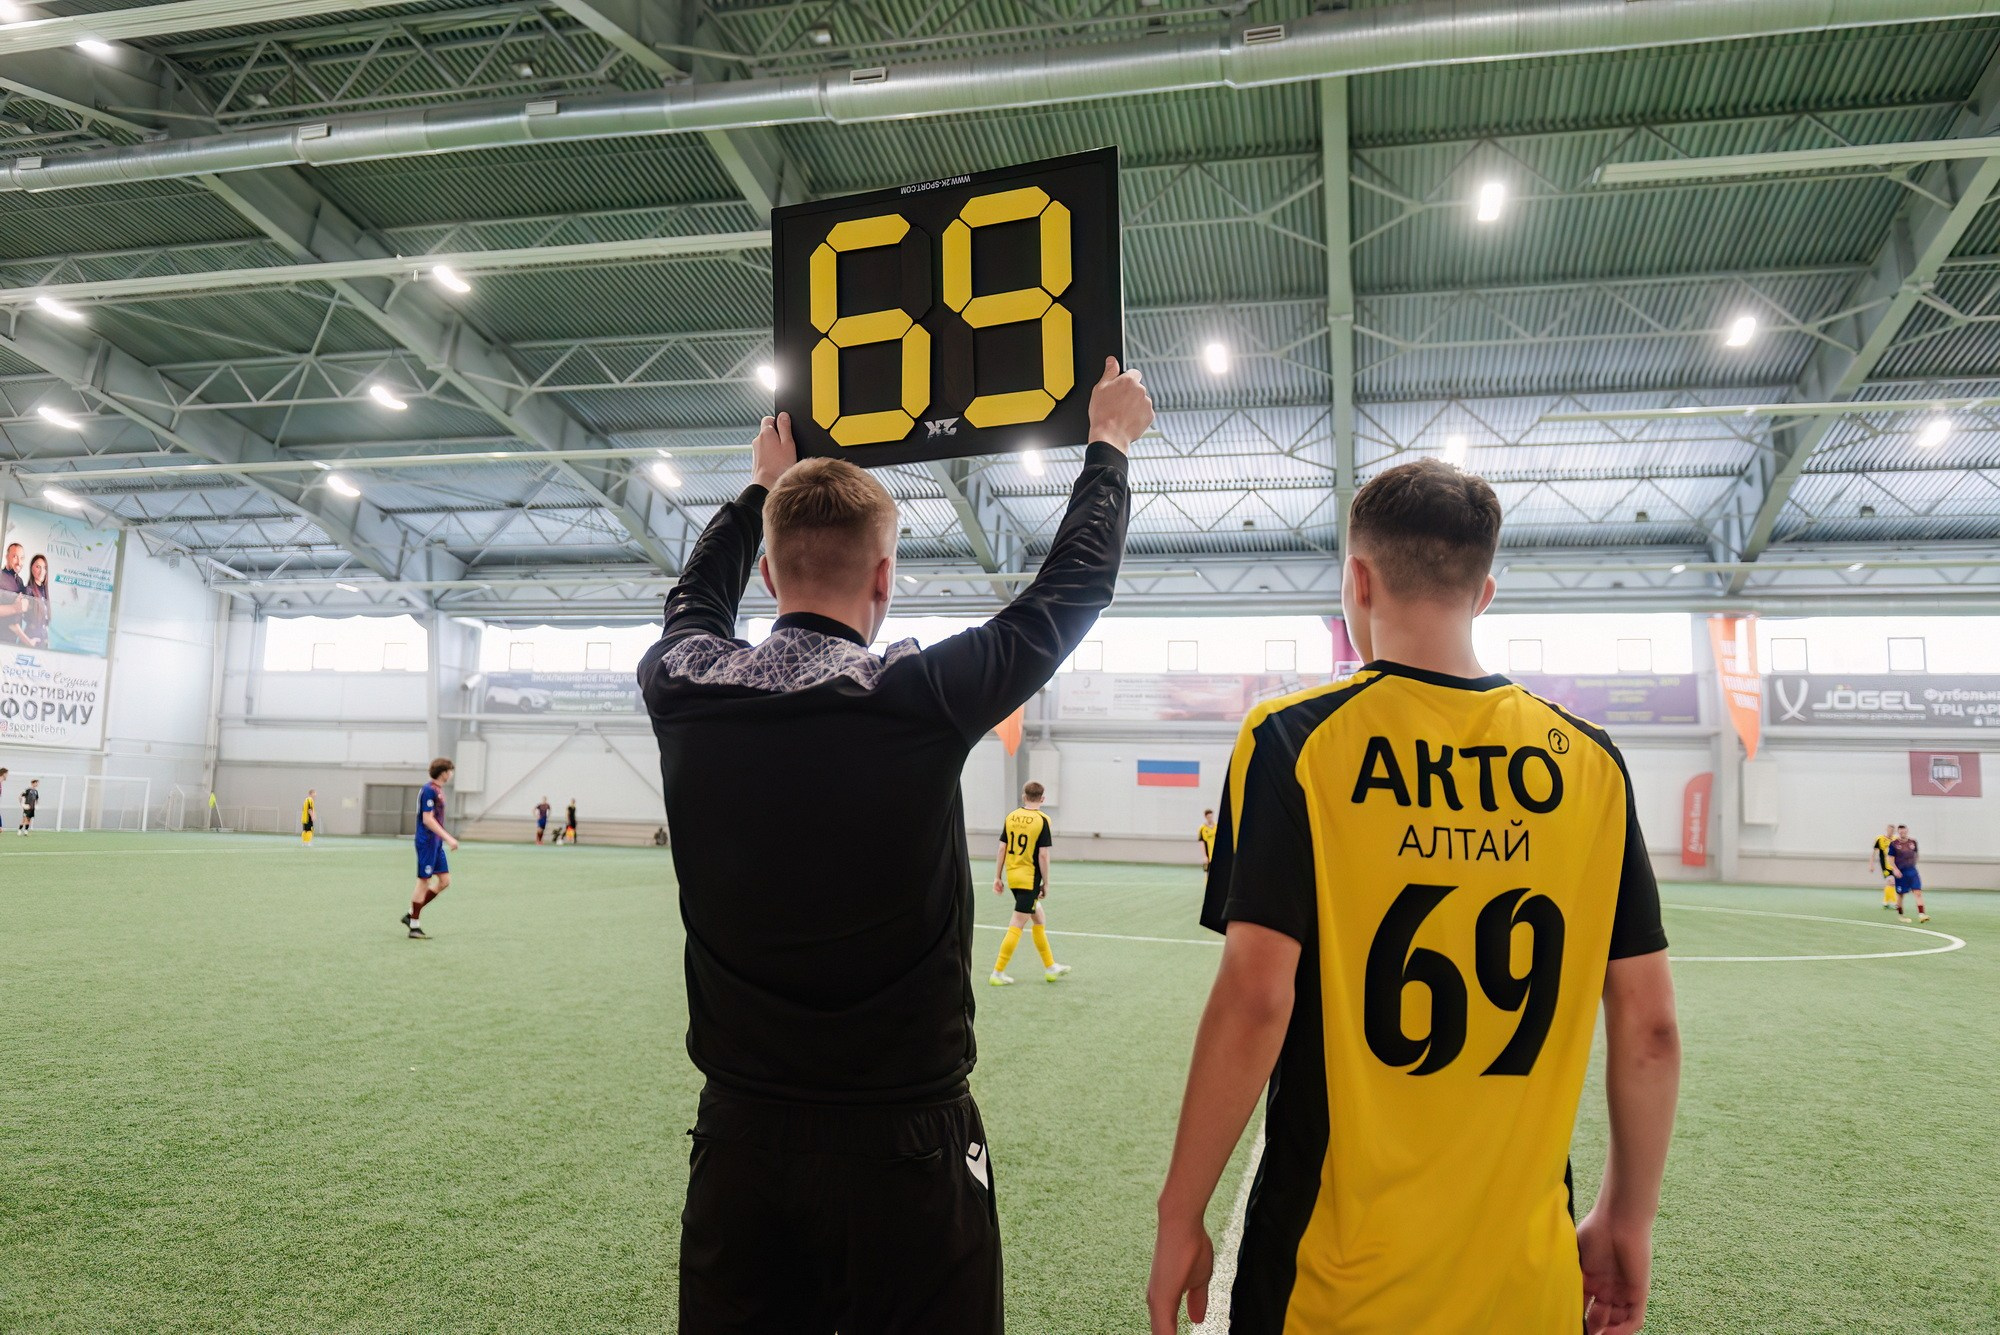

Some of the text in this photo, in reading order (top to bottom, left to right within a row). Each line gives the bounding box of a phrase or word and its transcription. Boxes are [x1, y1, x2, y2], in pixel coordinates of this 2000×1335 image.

[900, 175, 971, 195] WWW.2K-SPORT.COM
[809, 186, 1075, 447] 69
[15, 653, 41, 668] SL
[1, 682, 96, 703] СПОРТИВНУЮ
[0, 696, 94, 726] ФОРМУ
[1931, 703, 1965, 718] ТРЦ
[1350, 735, 1564, 814] АКТО
[1008, 831, 1028, 856] 19
[1397, 818, 1530, 862] АЛТАЙ
[1363, 883, 1566, 1077] 69
